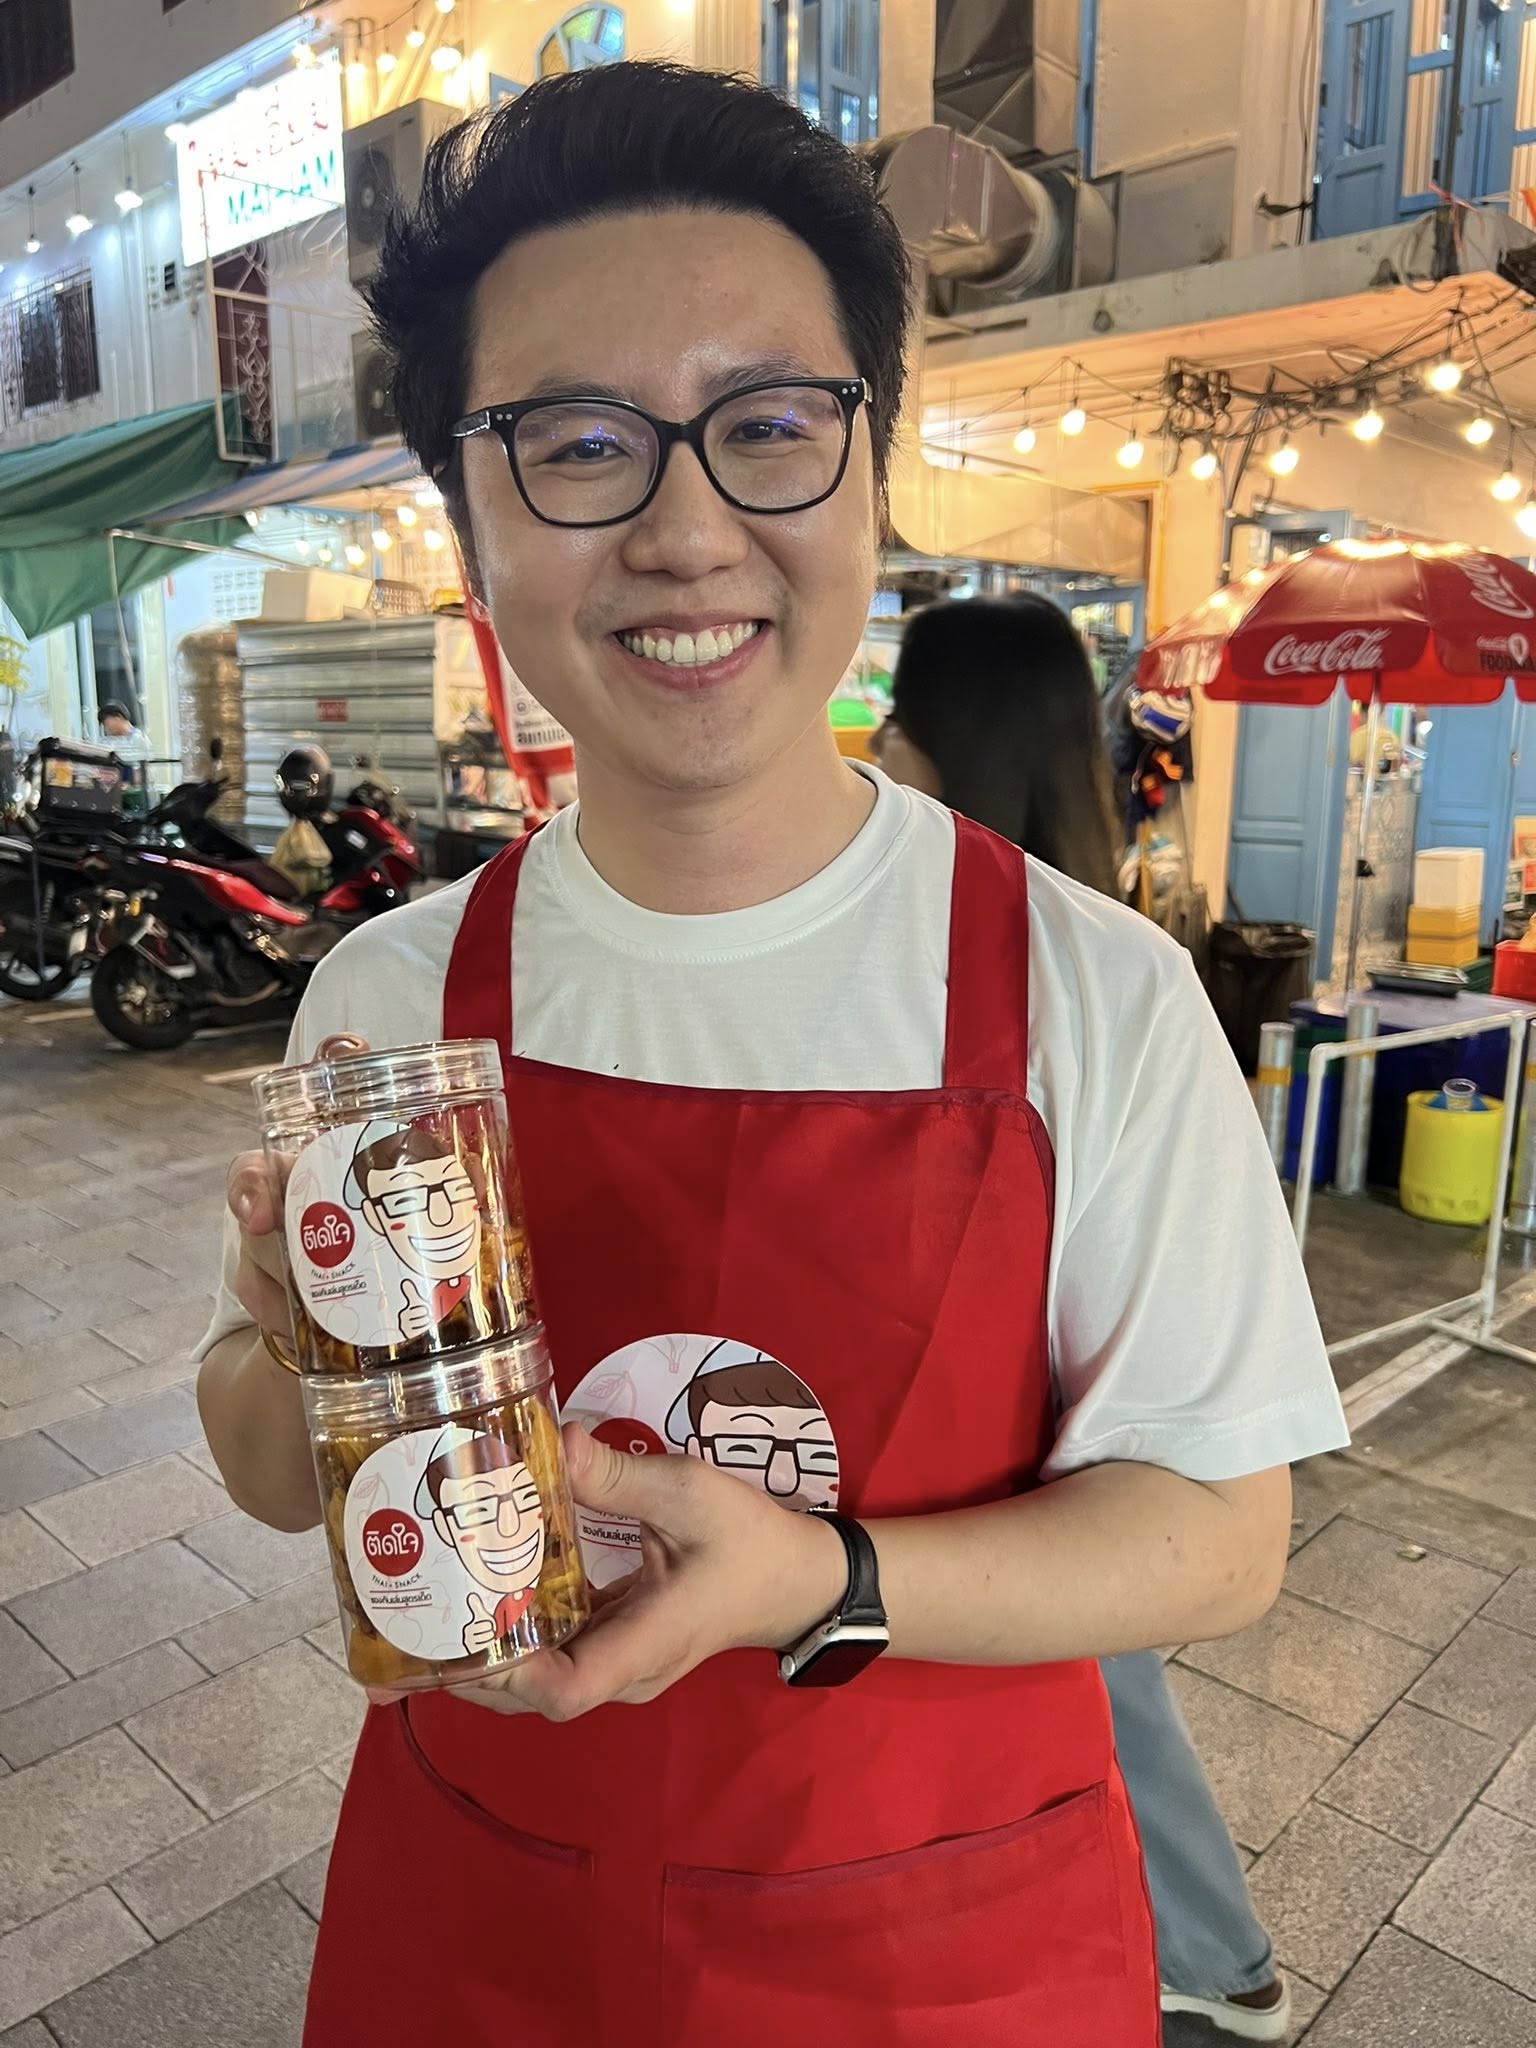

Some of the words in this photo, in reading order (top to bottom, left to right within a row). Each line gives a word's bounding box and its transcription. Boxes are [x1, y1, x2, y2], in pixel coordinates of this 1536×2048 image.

[1264, 627, 1392, 676] Coca-Cola
[303, 1214, 351, 1250] ติดใจ
[366, 1522, 419, 1556] ติดใจ
[583, 1524, 641, 1545] ของกินเล่นสูตร
[395, 1573, 422, 1589] SNACK
